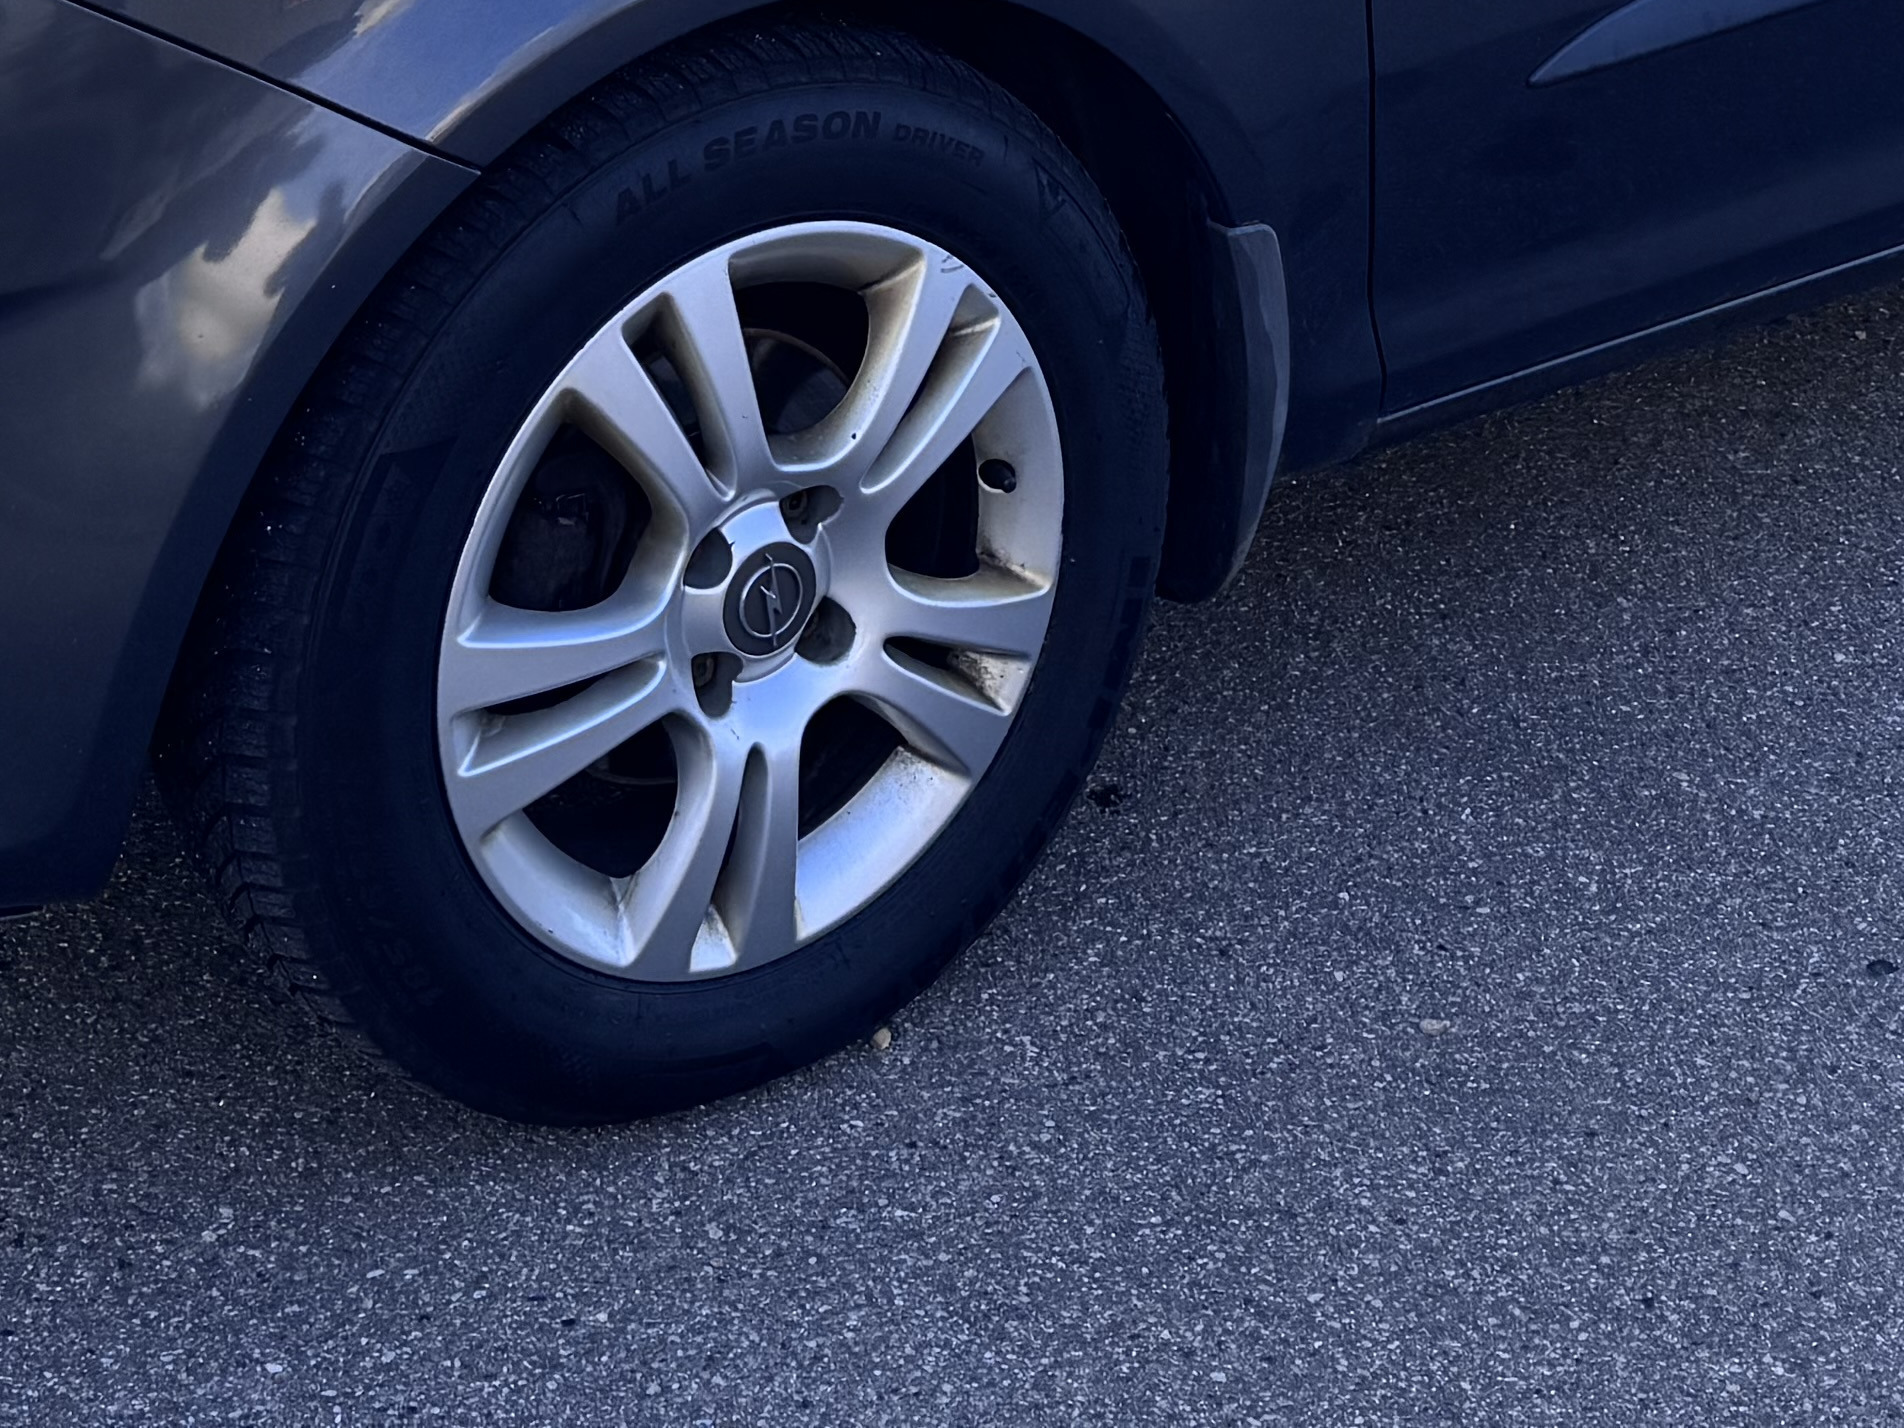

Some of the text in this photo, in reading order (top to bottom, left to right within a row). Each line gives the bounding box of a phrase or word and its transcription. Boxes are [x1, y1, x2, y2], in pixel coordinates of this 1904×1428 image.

[615, 110, 986, 226] ALL SEASON DRIVER
